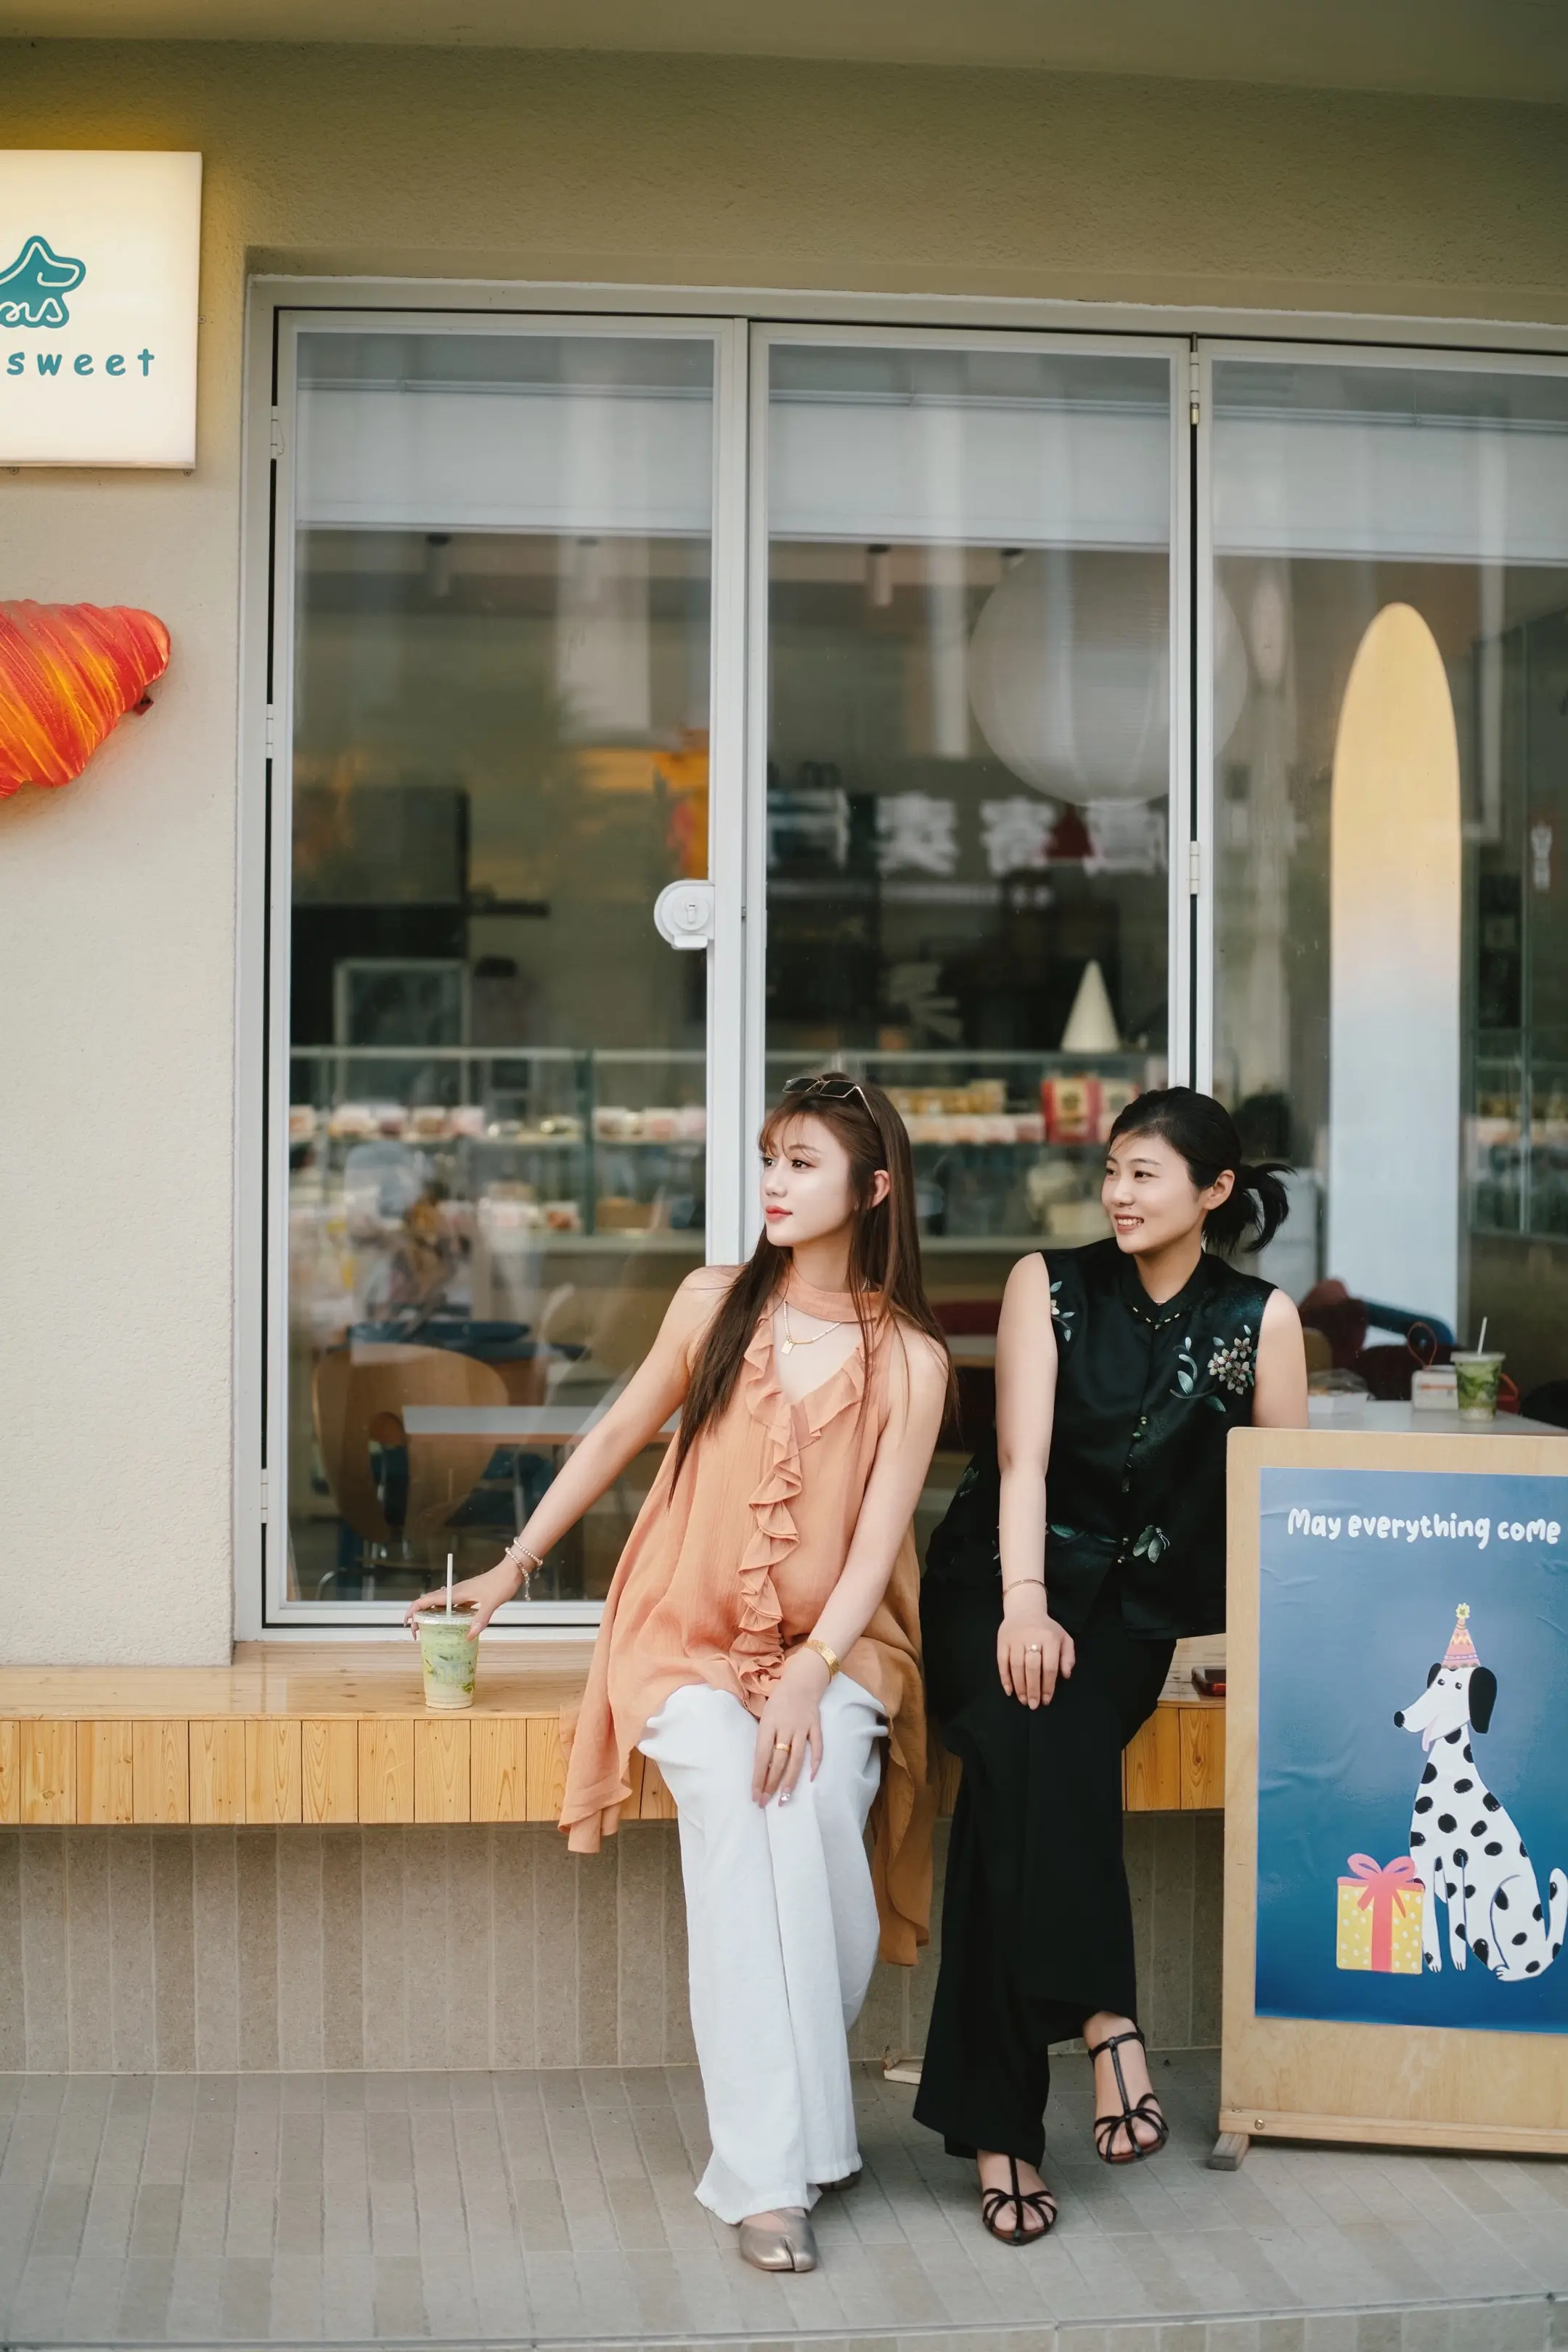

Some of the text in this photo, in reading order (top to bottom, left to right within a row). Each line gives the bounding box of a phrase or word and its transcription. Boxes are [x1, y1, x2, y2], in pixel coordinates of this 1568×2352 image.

[7, 348, 155, 376] sweet
[1287, 1508, 1561, 1550] May everything come
